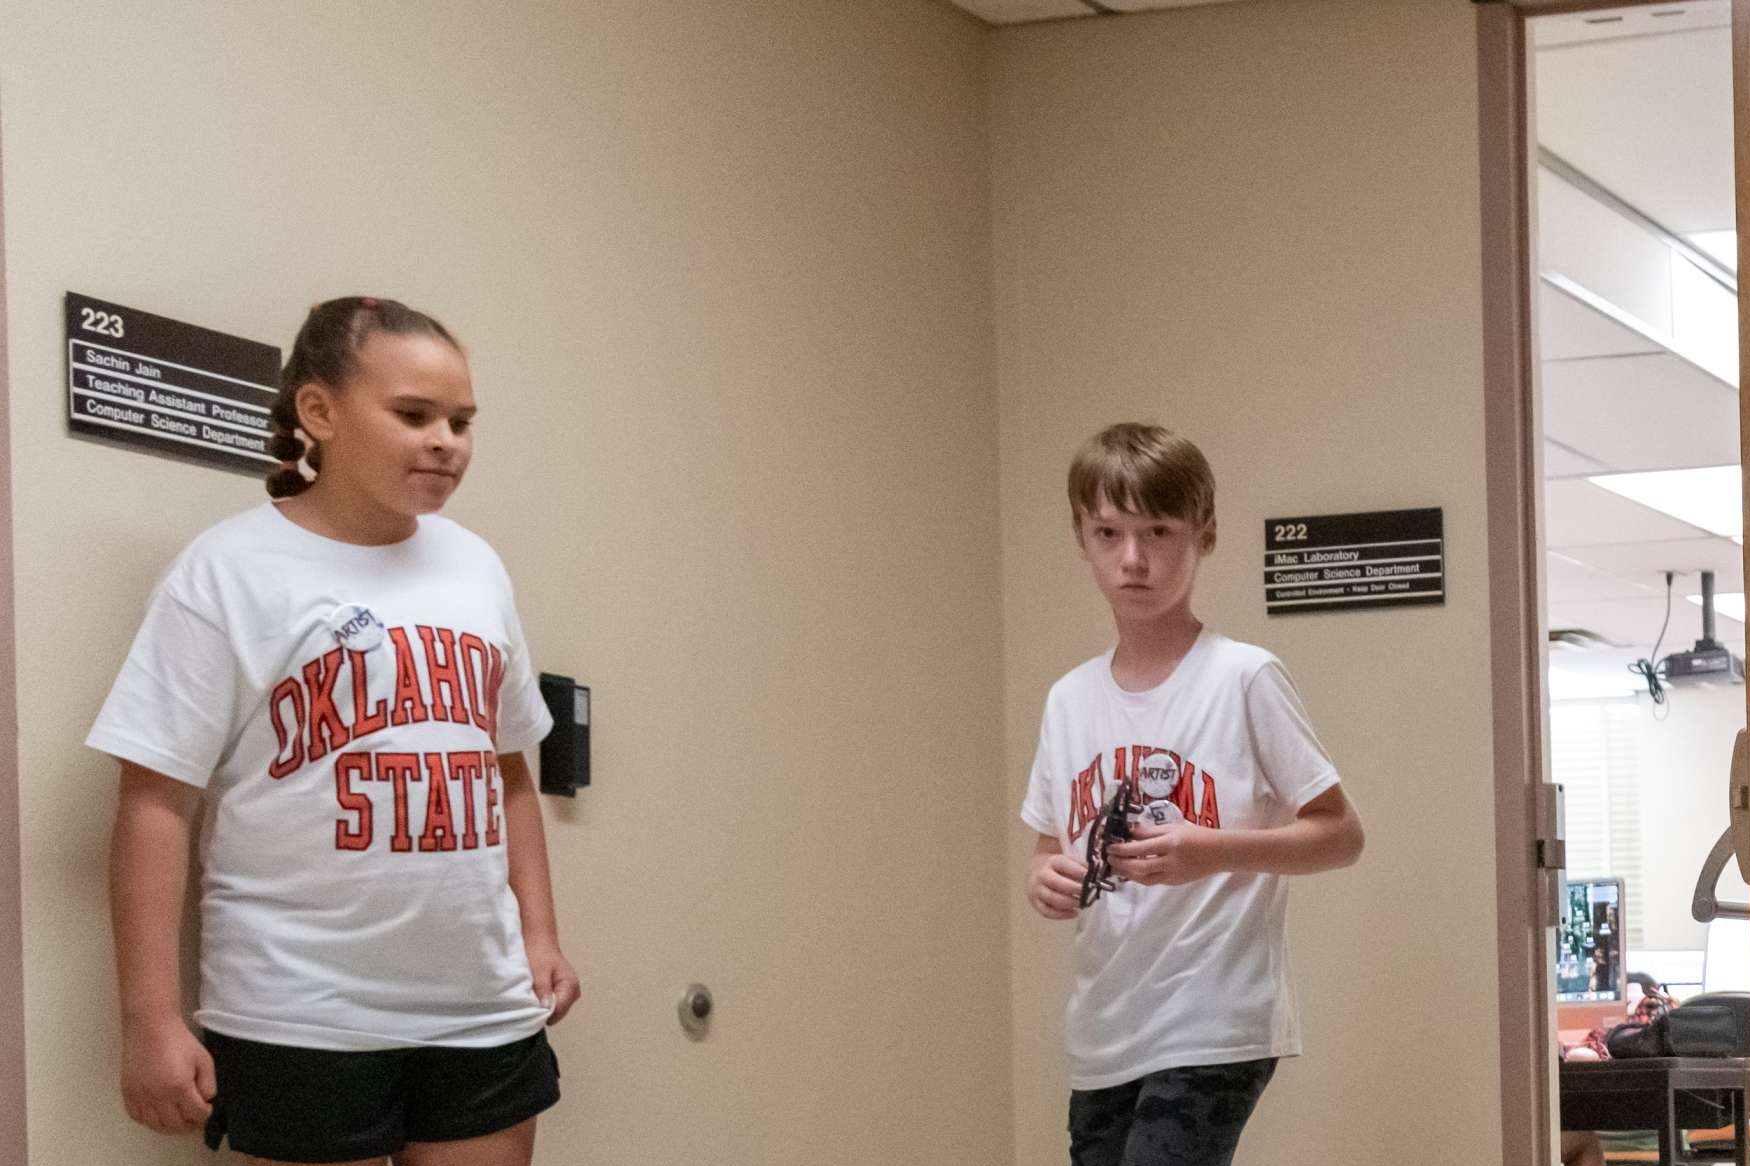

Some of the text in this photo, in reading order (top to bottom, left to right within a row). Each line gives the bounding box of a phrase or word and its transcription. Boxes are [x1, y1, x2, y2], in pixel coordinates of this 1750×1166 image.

[81, 307, 125, 338] 223
[86, 349, 161, 379] Sachin Jain
[86, 374, 268, 428] Teaching Assistant Professor
[86, 399, 266, 451] Computer Science Department
[1274, 523, 1308, 542] 222
[1274, 550, 1360, 565] iMac Laboratory
[1274, 563, 1420, 584] Computer Science Department
[333, 608, 376, 644] ARTIST
[1140, 766, 1176, 781] ARTIST
[334, 751, 501, 852] STATE
